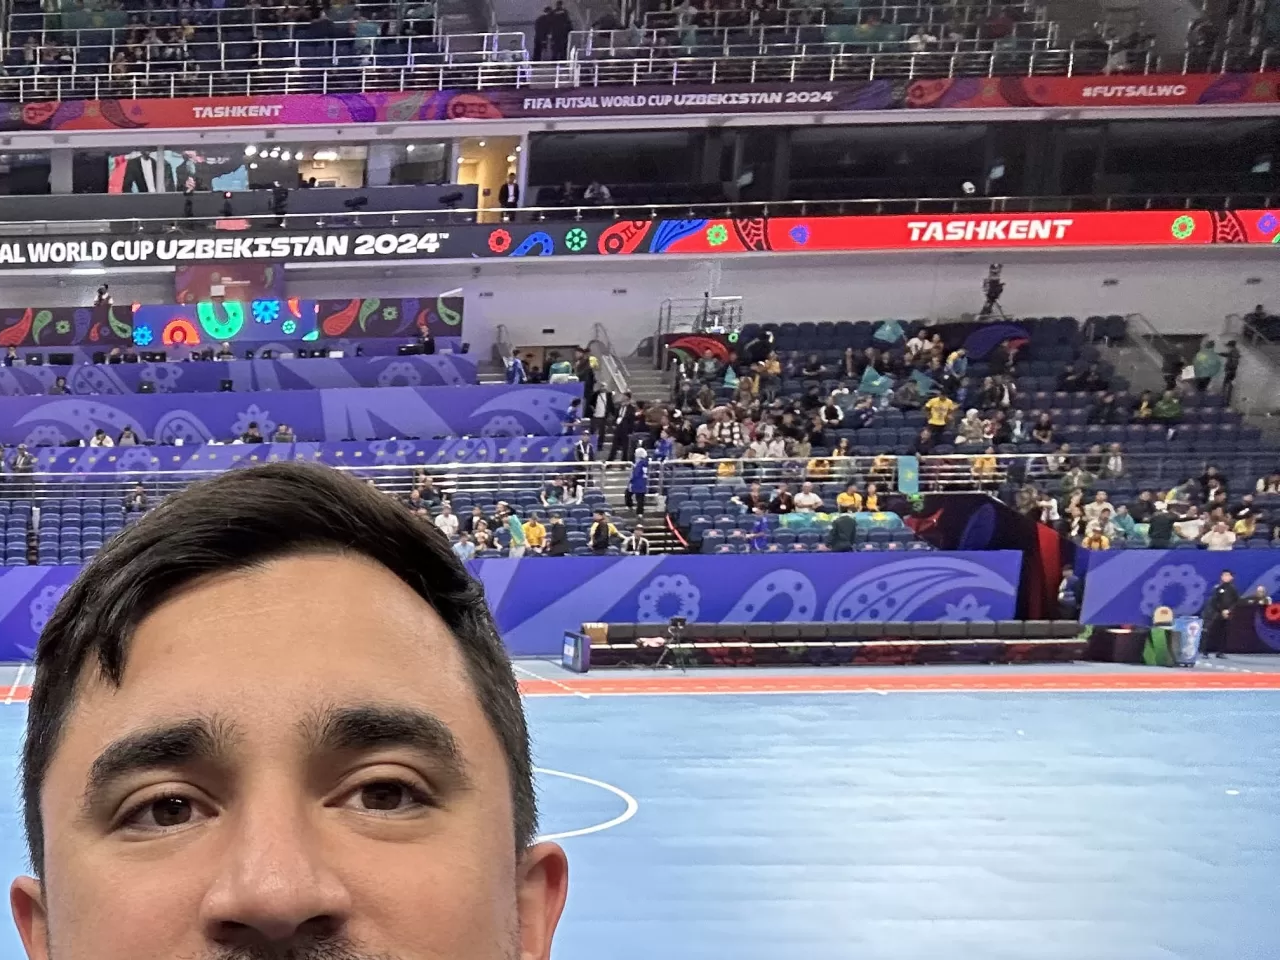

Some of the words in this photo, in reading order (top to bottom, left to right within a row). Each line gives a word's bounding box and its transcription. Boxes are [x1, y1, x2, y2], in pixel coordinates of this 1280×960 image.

[1082, 84, 1187, 97] #FUTSALWC
[523, 98, 553, 110] FIFA
[555, 96, 599, 109] FUTSAL
[600, 95, 646, 108] WORLD
[647, 94, 673, 107] CUP
[674, 92, 782, 106] UZBEKISTAN
[192, 104, 283, 119] TASHKENT
[907, 219, 1073, 241] TASHKENT
[27, 241, 107, 262] WORLD
[110, 240, 154, 261] CUP
[156, 235, 348, 260] UZBEKISTAN
